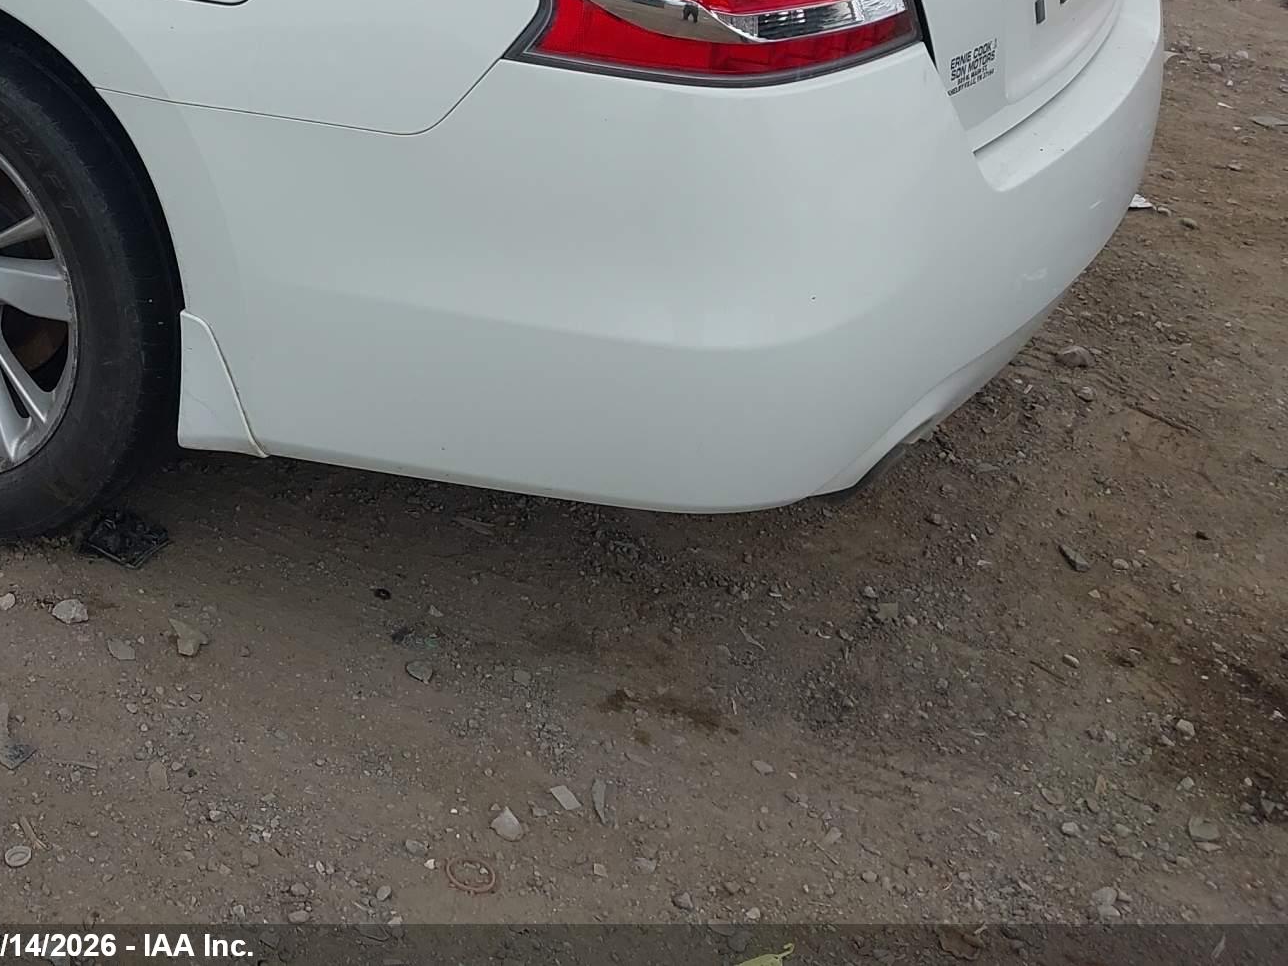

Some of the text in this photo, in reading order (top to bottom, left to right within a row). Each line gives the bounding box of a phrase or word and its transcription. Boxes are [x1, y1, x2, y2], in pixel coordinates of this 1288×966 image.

[950, 50, 972, 70] ERNIE
[973, 40, 992, 59] COOK
[950, 49, 995, 81] SON MOTORS
